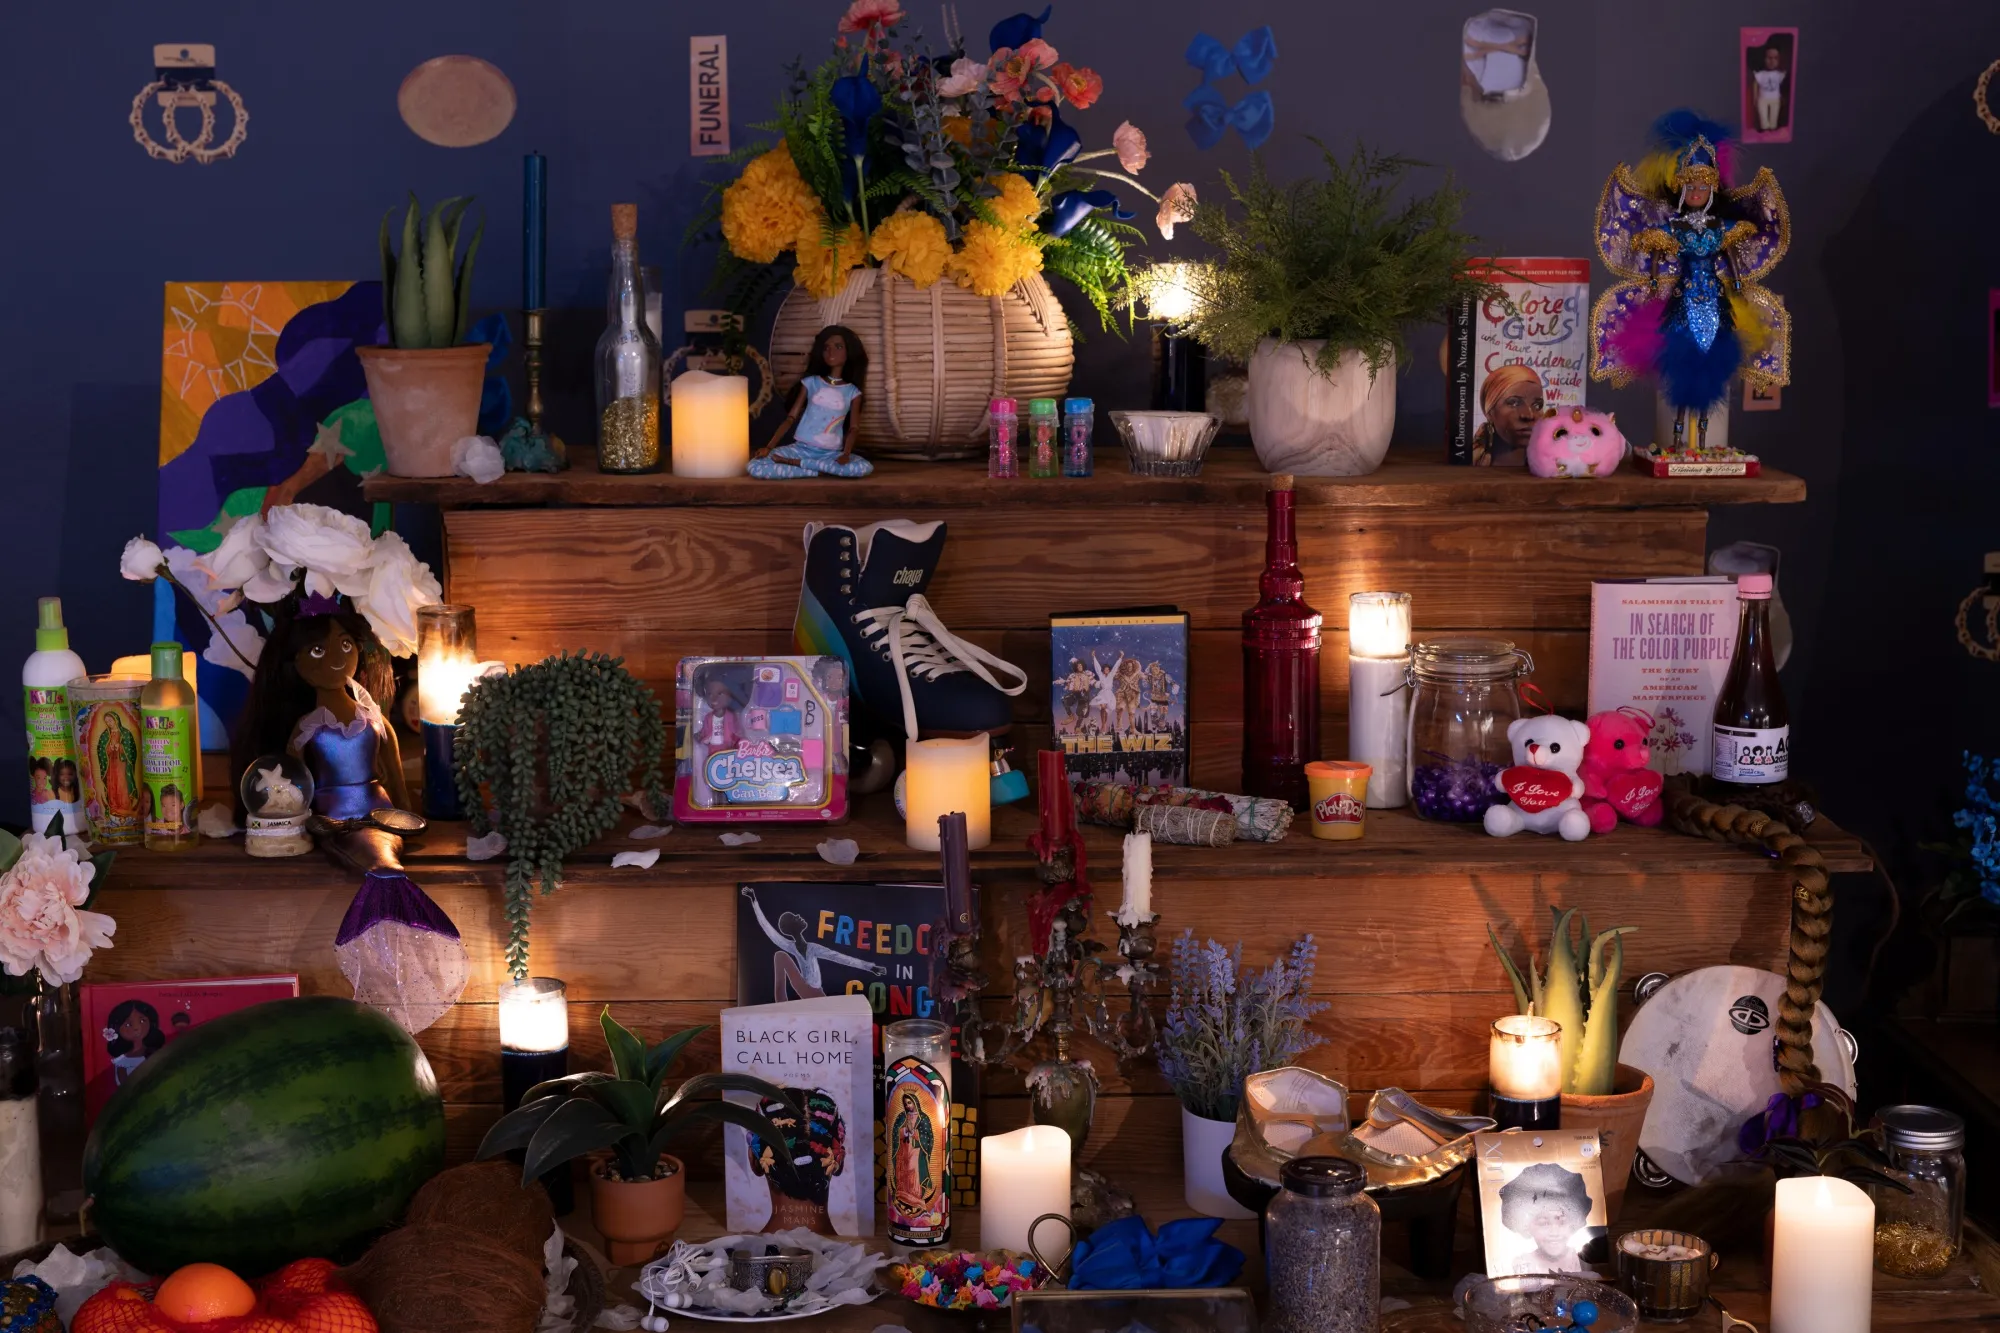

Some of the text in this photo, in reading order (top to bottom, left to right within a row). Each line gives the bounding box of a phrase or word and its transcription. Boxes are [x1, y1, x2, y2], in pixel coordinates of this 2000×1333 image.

[699, 44, 721, 145] FUNERAL
[1482, 285, 1582, 328] Colored
[1502, 315, 1576, 345] Girls
[1457, 329, 1469, 368] Ntozake
[1481, 333, 1531, 353] who have
[1484, 350, 1584, 374] Considered
[1456, 372, 1470, 384] by
[1541, 369, 1582, 388] Suicide
[1546, 389, 1578, 400] When
[1455, 386, 1469, 447] Choreopoem
[1454, 451, 1465, 459] A
[892, 566, 924, 587] chaya
[1630, 613, 1715, 636] IN SEARCH OF
[1613, 638, 1730, 660] THE COLOR PURPLE
[30, 690, 64, 705] Kids
[146, 716, 175, 730] Kids
[738, 741, 774, 758] Barbie
[1060, 732, 1172, 754] THE WIZ
[711, 755, 799, 785] Chelsea
[731, 790, 756, 799] Can
[1511, 782, 1560, 797] I Love
[1621, 787, 1636, 804] I
[1316, 799, 1364, 820] Play-Doh
[1519, 796, 1546, 806] You
[267, 820, 292, 828] JAMAICA
[817, 909, 932, 956] FREEDO
[896, 964, 914, 980] IN
[736, 1030, 797, 1044] BLACK
[807, 1030, 858, 1045] GIRL,
[736, 1051, 853, 1065] CALL HOME
[775, 1205, 825, 1215] JASMINE
[783, 1216, 816, 1226] MANS
